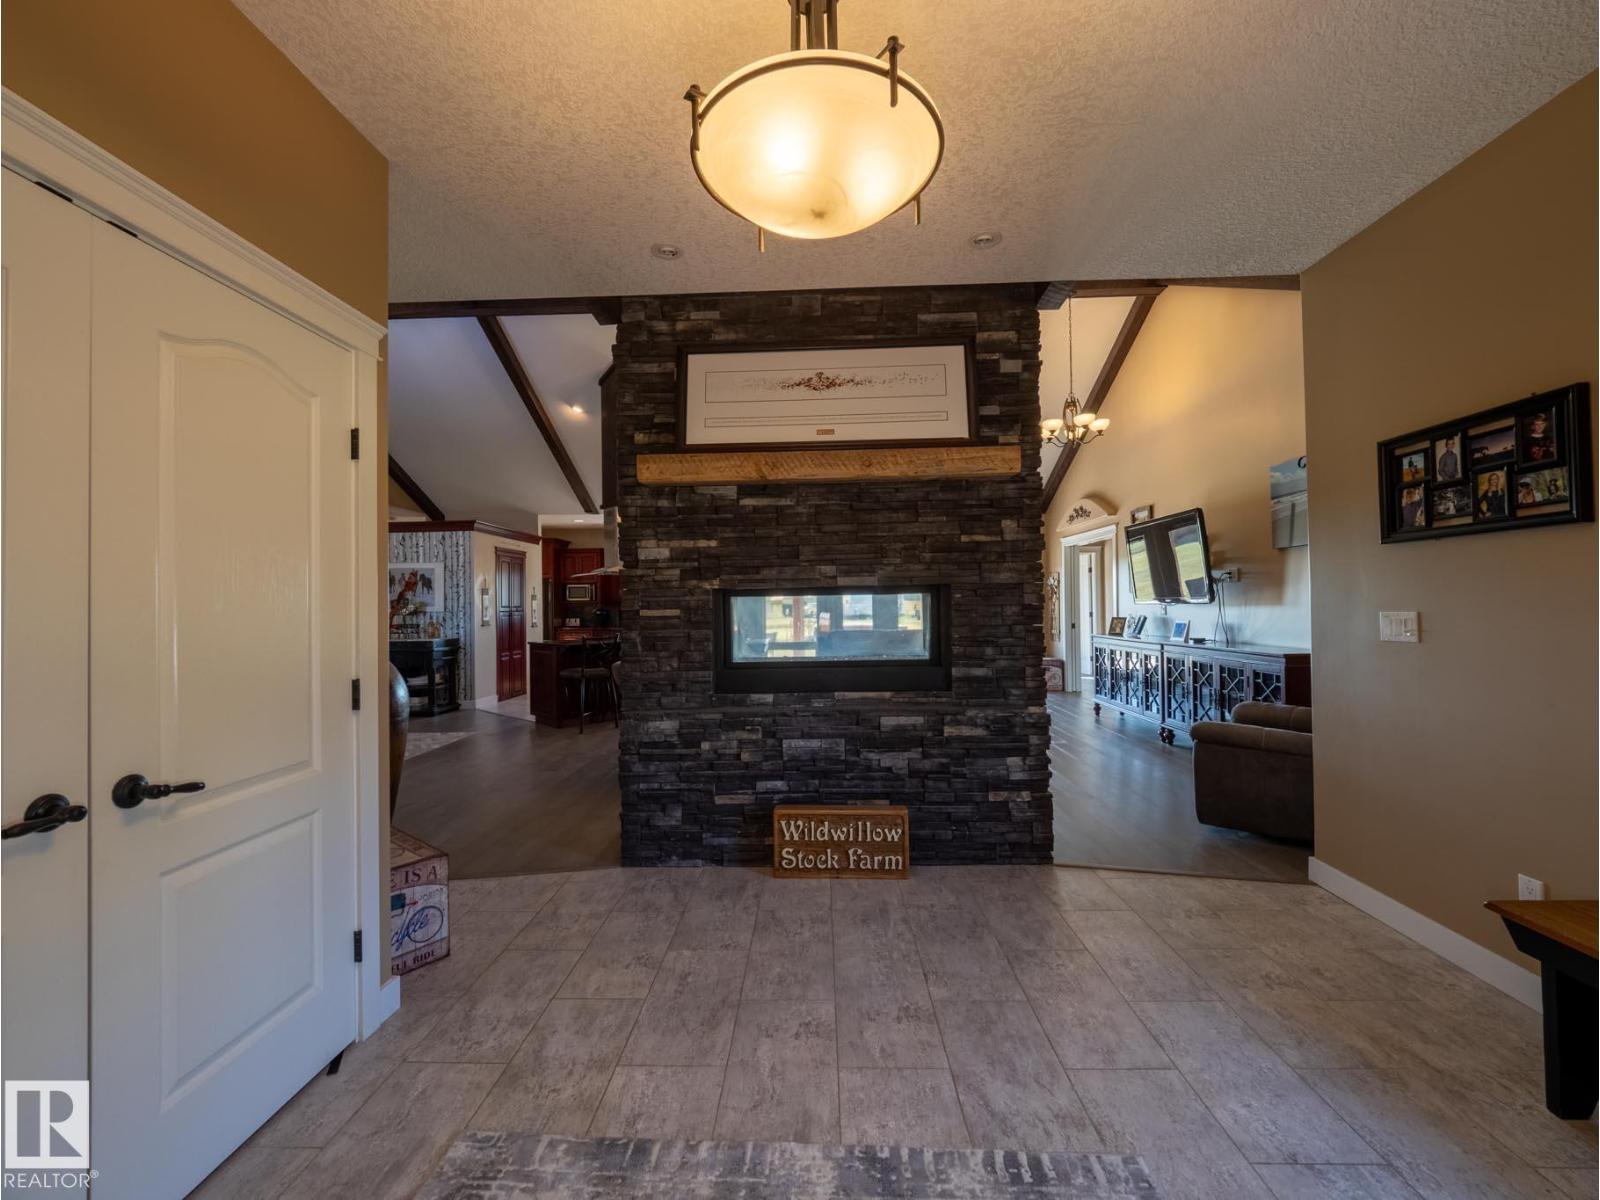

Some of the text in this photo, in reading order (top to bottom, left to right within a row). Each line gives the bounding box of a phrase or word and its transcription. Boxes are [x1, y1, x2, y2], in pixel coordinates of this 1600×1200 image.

[780, 819, 902, 842] Wildwillow
[781, 848, 903, 870] Stock Farm
[403, 867, 422, 884] IS
